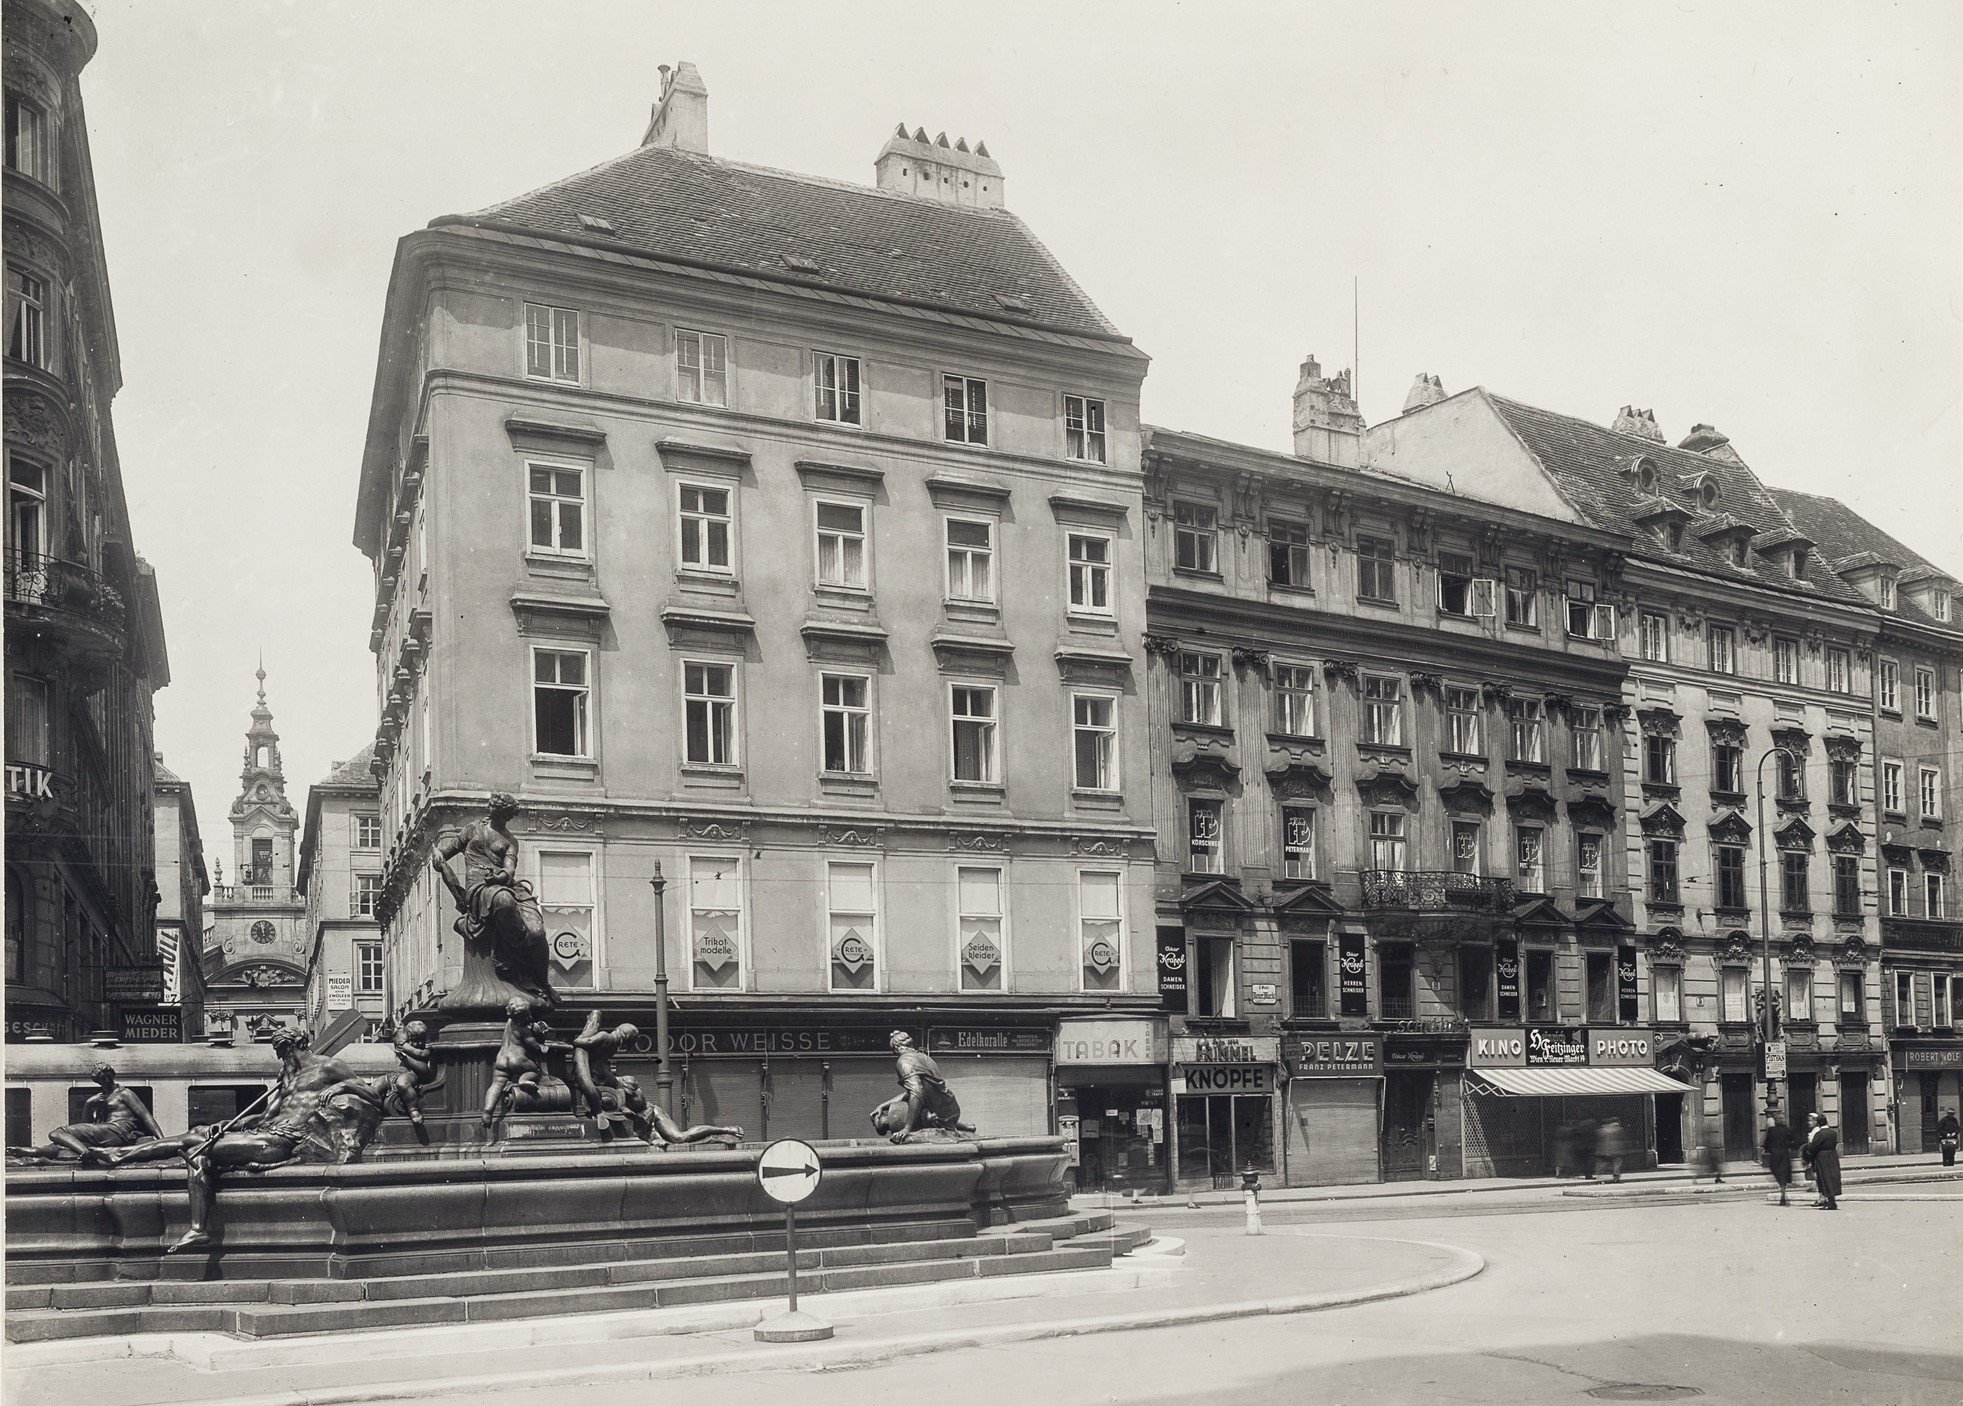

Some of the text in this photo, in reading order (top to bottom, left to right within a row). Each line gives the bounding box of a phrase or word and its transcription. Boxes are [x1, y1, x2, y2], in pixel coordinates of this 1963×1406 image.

[700, 946, 732, 955] modelle
[968, 951, 996, 960] kleider
[124, 1014, 178, 1025] WAGNER
[124, 1027, 178, 1038] MIEDER
[730, 1032, 831, 1050] WEISSE
[1062, 1039, 1138, 1059] TABAK
[1300, 1041, 1375, 1062] PELZE
[1477, 1038, 1523, 1056] KINO
[1595, 1038, 1649, 1056] PHOTO
[1909, 1052, 1939, 1061] ROBERT
[1184, 1066, 1264, 1089] KNÖPFE
